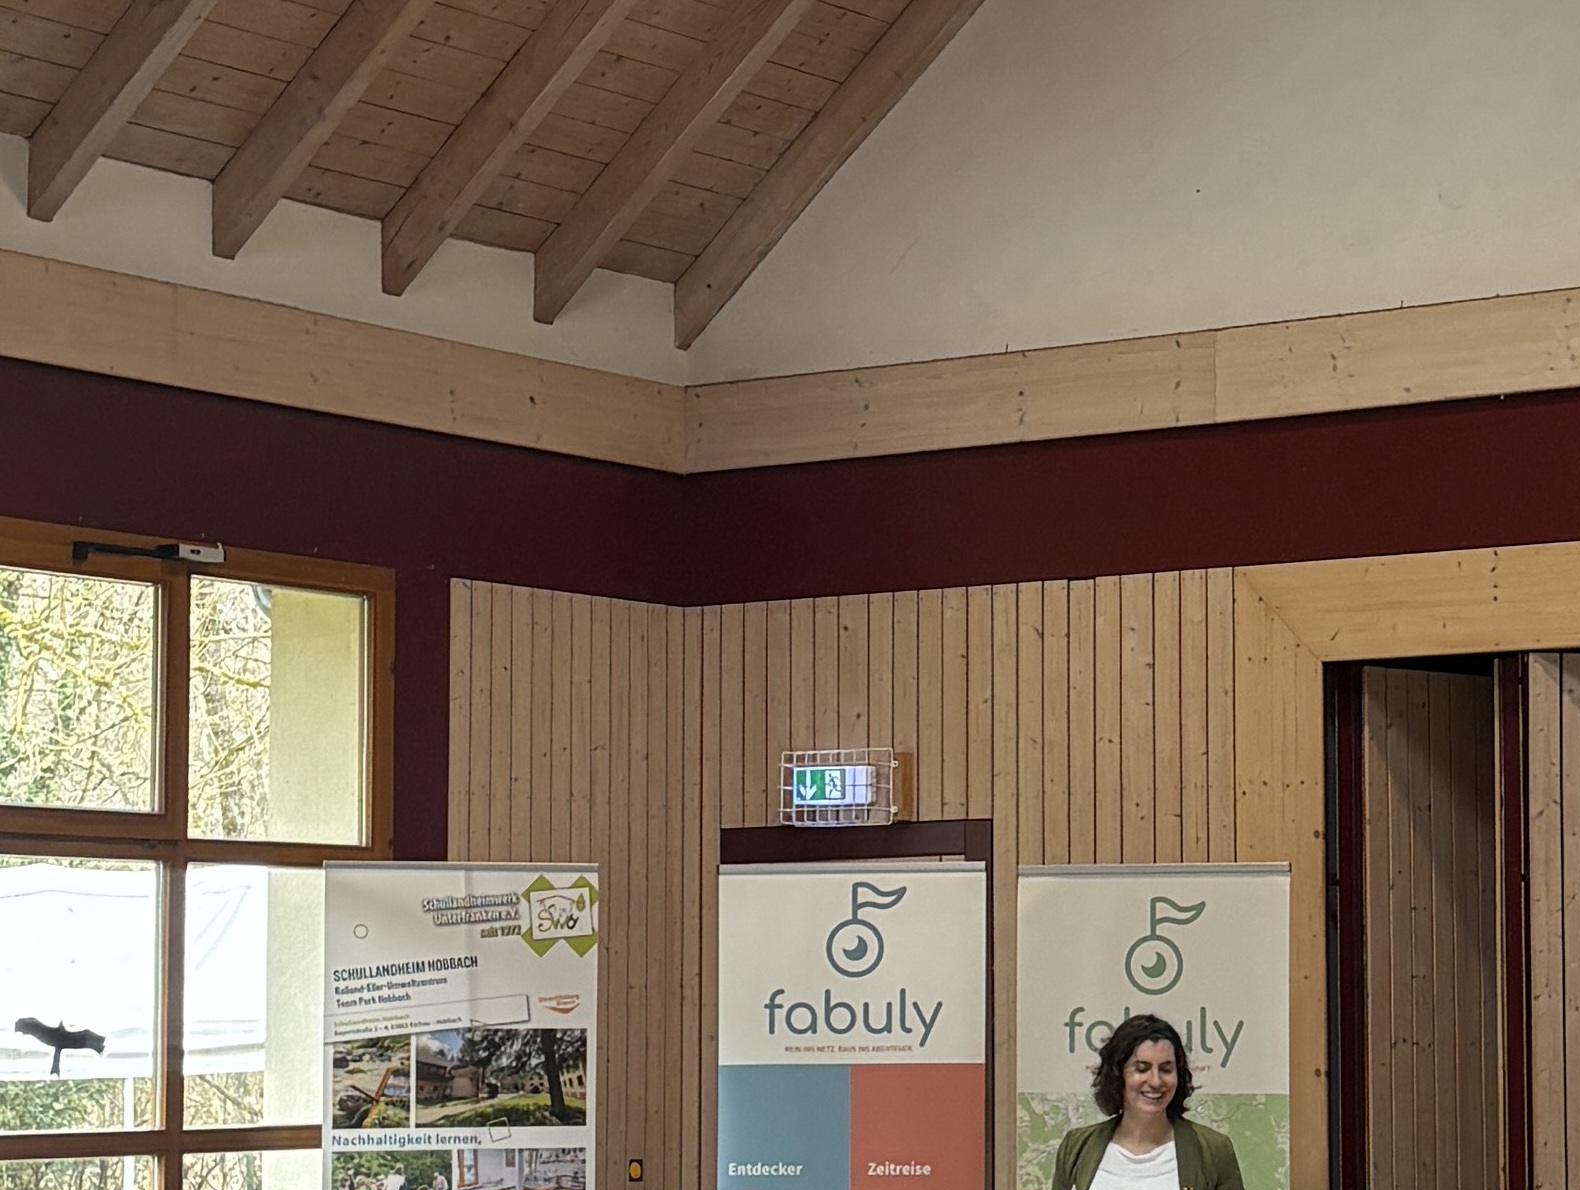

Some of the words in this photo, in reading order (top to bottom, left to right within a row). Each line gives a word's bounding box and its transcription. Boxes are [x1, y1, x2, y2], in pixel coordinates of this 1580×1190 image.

[333, 960, 425, 982] SCHULLANDHEIM
[427, 955, 478, 973] HOBBACH
[764, 988, 943, 1048] fabuly
[1064, 1006, 1244, 1068] faly
[332, 1133, 432, 1149] Nachhaltigkeit
[435, 1132, 482, 1147] lernen,
[728, 1161, 803, 1176] Entdecker
[867, 1162, 932, 1176] Zeitreise
